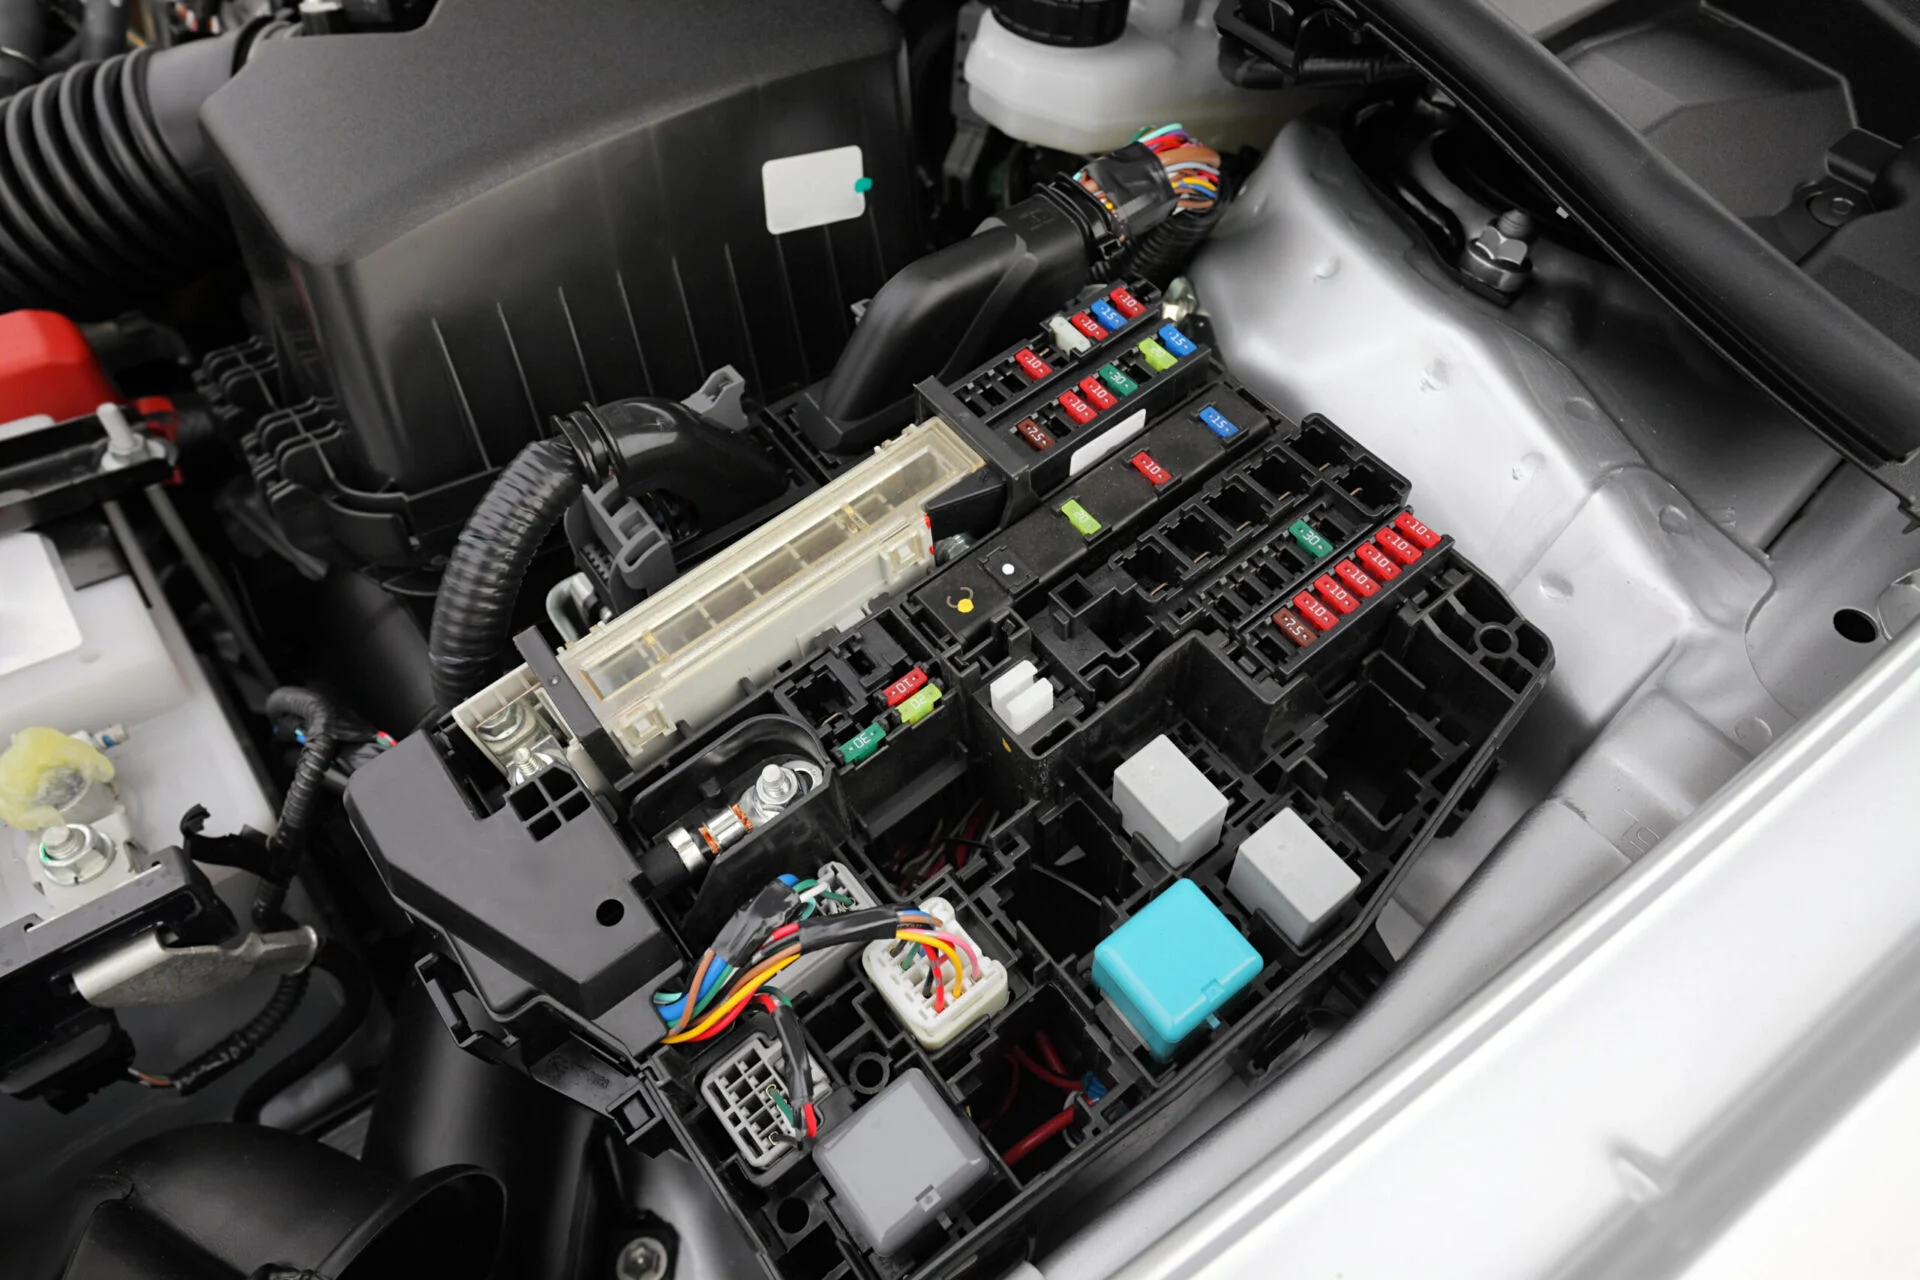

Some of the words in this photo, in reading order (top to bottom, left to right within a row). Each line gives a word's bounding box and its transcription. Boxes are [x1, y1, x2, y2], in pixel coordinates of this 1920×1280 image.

[1122, 294, 1137, 308] 10
[1102, 307, 1117, 321] 15
[1083, 319, 1097, 332] 10
[1170, 332, 1185, 346] 15
[1150, 344, 1165, 358] 20
[1028, 355, 1042, 369] 10
[1110, 371, 1126, 385] 30
[1091, 384, 1106, 399] 10
[1070, 398, 1086, 413] 10
[1210, 413, 1227, 428] 15
[1029, 426, 1044, 443] 7.5
[1144, 460, 1161, 475] 10
[1073, 509, 1090, 523] 20
[1409, 520, 1428, 536] 10
[1302, 529, 1320, 546] 30
[1391, 535, 1408, 551] 10
[1371, 551, 1390, 568] 10
[1350, 568, 1368, 586] 10
[1330, 584, 1348, 601] 10
[1308, 600, 1326, 618] 10
[1284, 617, 1304, 636] 7.5
[895, 678, 913, 693] 10
[908, 693, 927, 709] 20
[852, 731, 872, 748] 30
